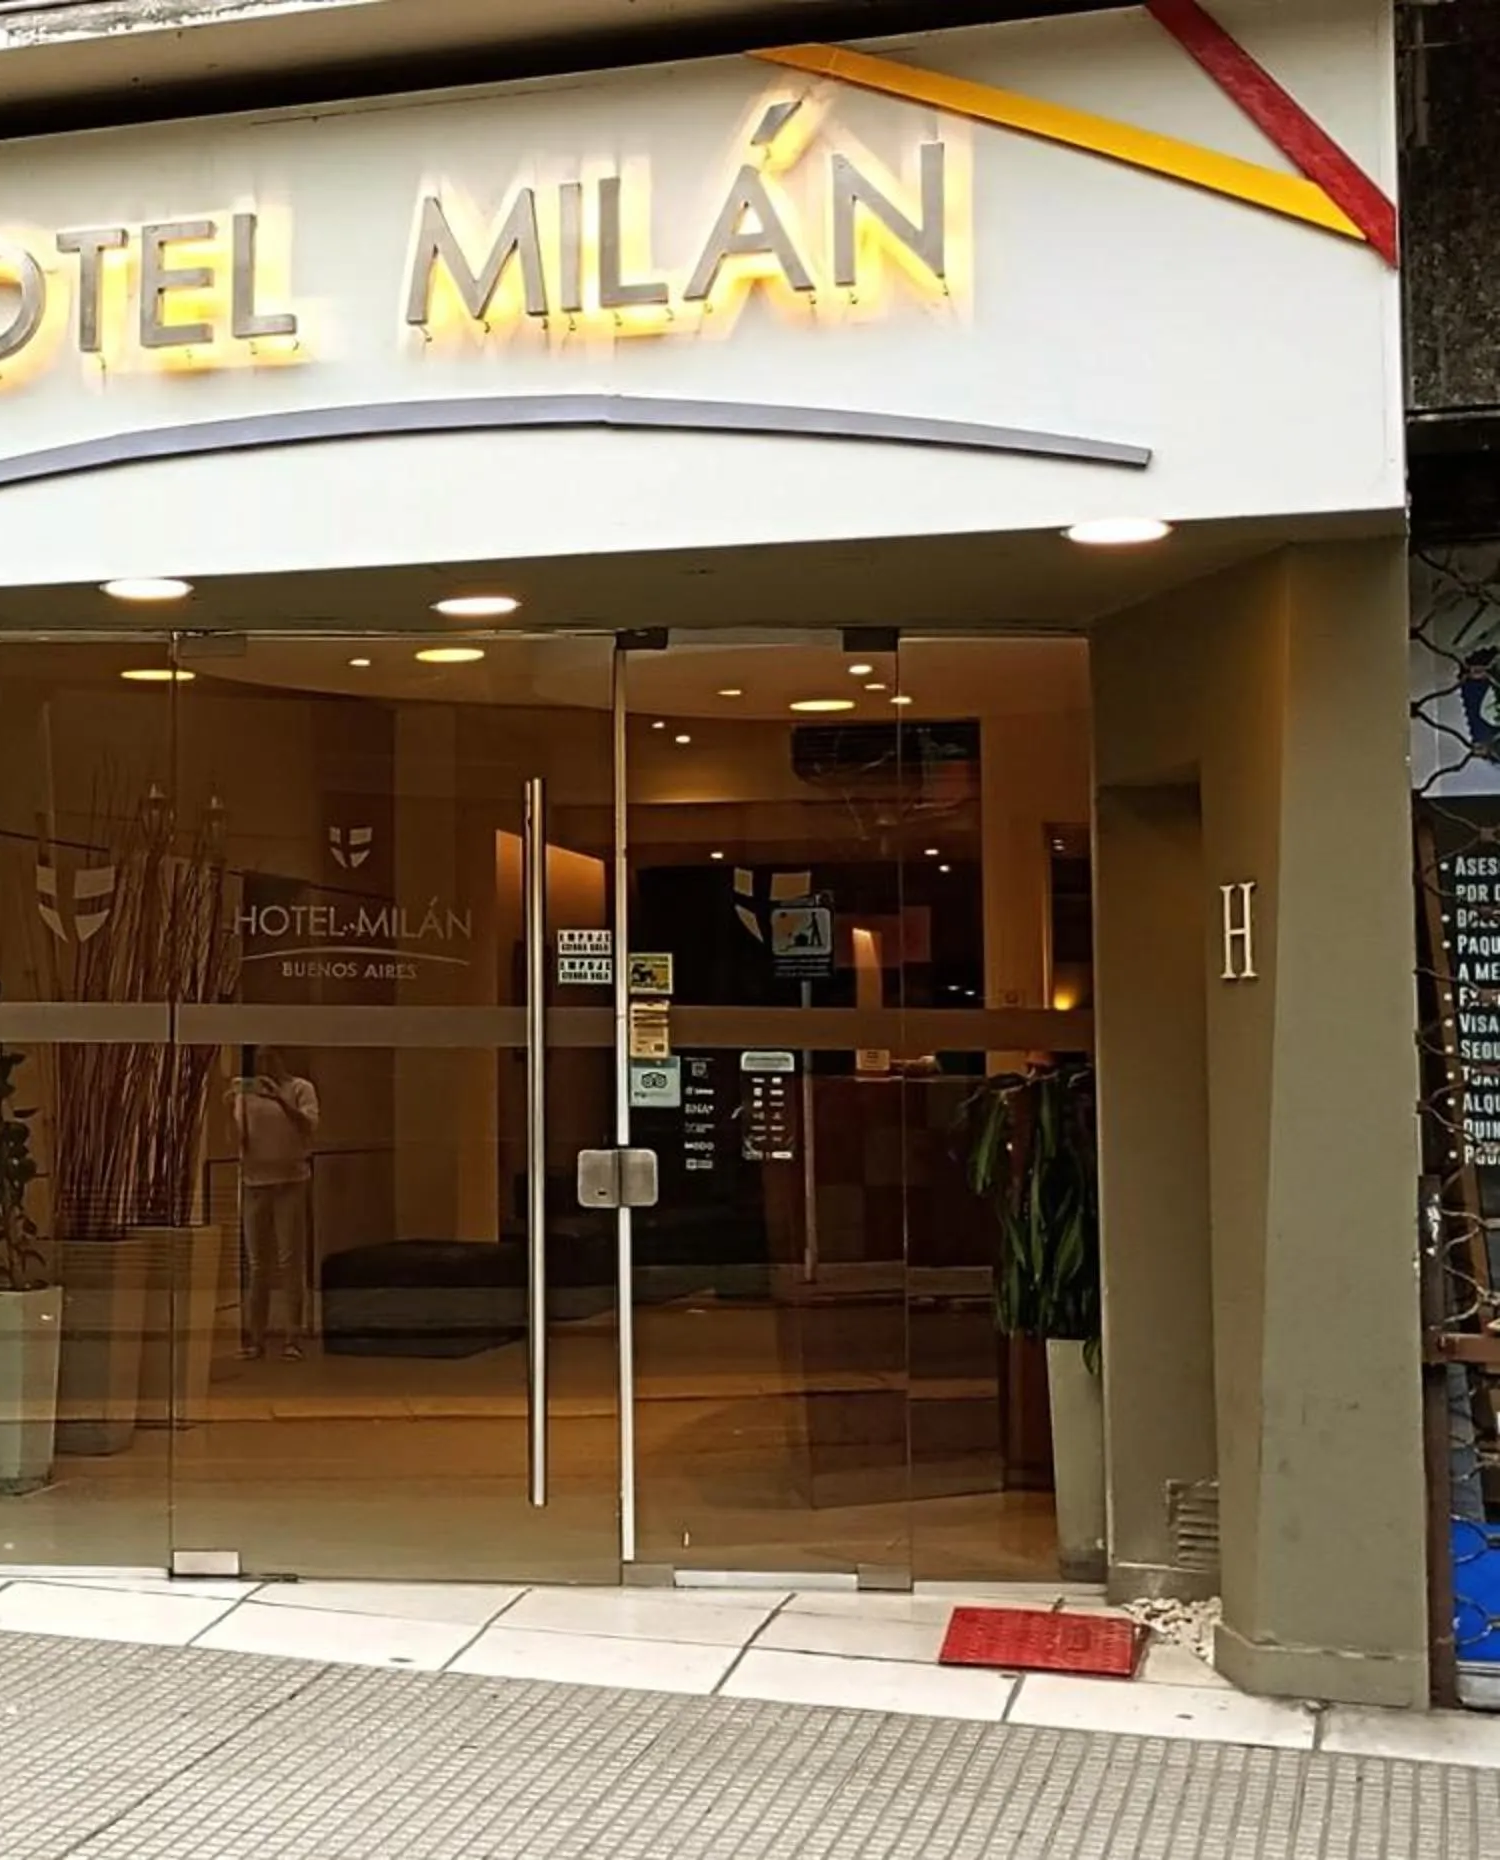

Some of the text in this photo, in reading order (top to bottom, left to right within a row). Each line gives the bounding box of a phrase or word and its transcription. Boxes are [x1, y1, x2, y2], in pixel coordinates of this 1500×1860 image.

[407, 99, 946, 326] MILÁN
[1455, 884, 1490, 902] POR
[233, 896, 472, 940] HOTEL MILÁN
[1219, 881, 1258, 979] H
[282, 961, 417, 979] BUENOS AIRES
[1458, 962, 1469, 981] A
[1459, 1013, 1499, 1033] VISA
